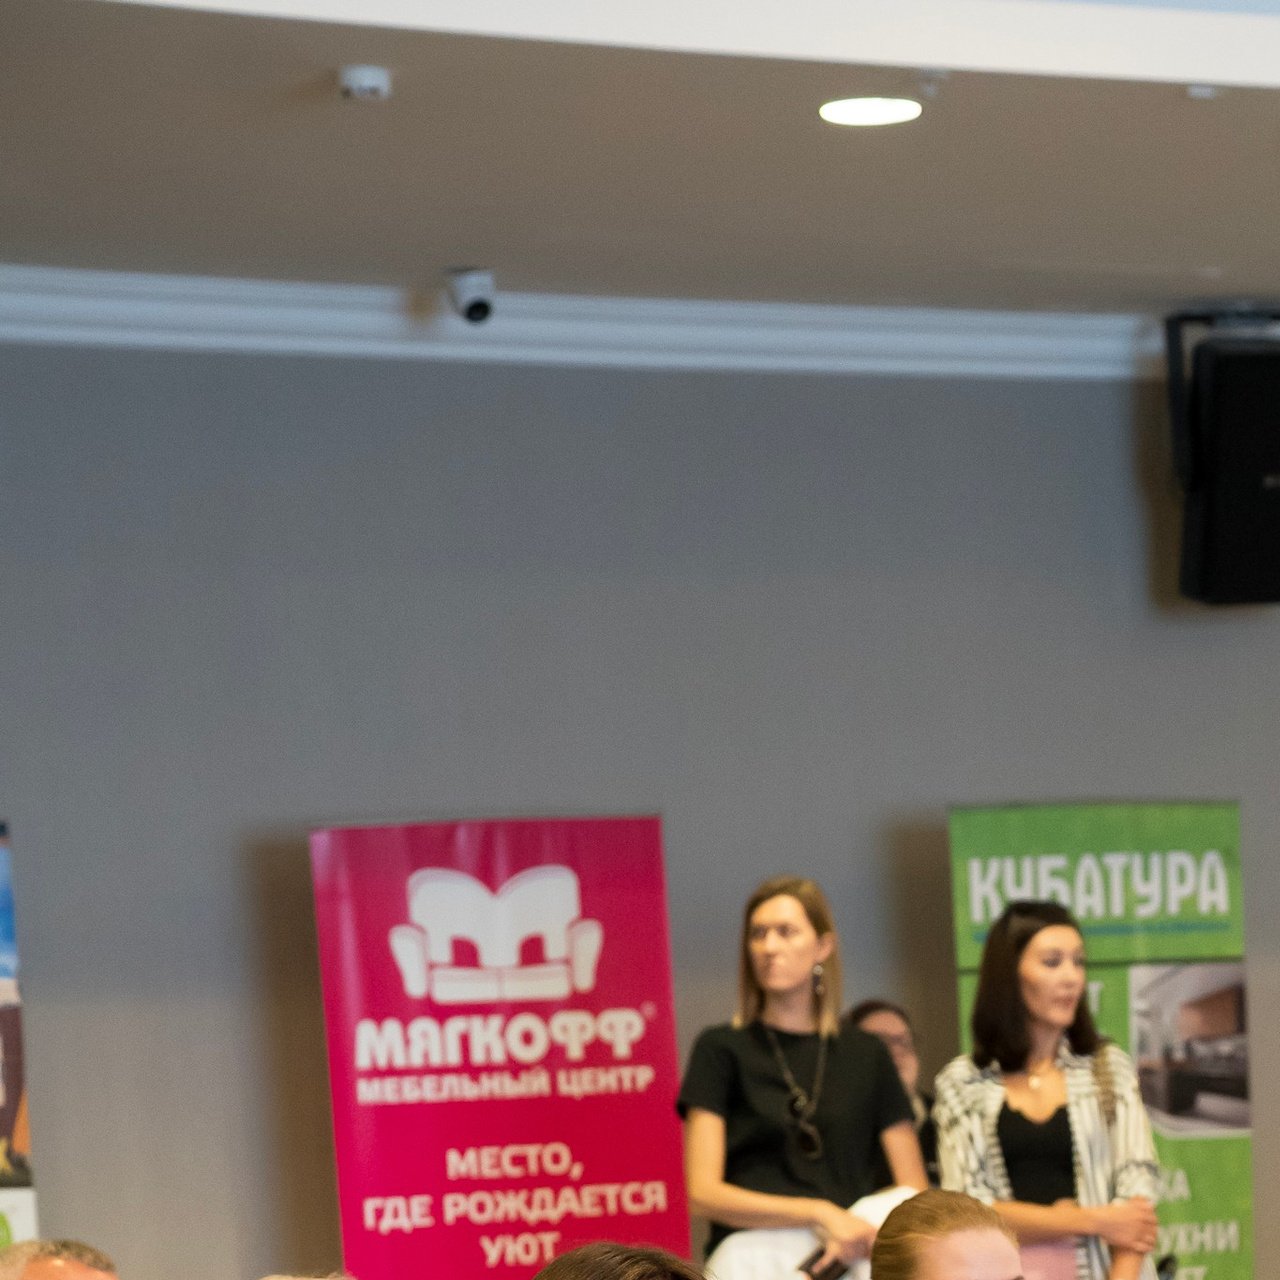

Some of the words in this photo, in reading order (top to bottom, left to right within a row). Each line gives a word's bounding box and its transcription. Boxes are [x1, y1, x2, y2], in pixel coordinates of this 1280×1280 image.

[968, 850, 1230, 924] КУБАТУРА
[355, 1007, 645, 1069] МЯГКОФФ
[356, 1066, 551, 1106] МЕБЕЛЬНЫЙ
[557, 1064, 656, 1100] ЦЕНТР
[445, 1141, 584, 1181] МЕСТО,
[363, 1193, 435, 1235] ГДЕ
[442, 1180, 669, 1226] РОЖДАЕТСЯ
[479, 1230, 561, 1269] УЮТ
[1156, 1218, 1241, 1255] УХНИ
